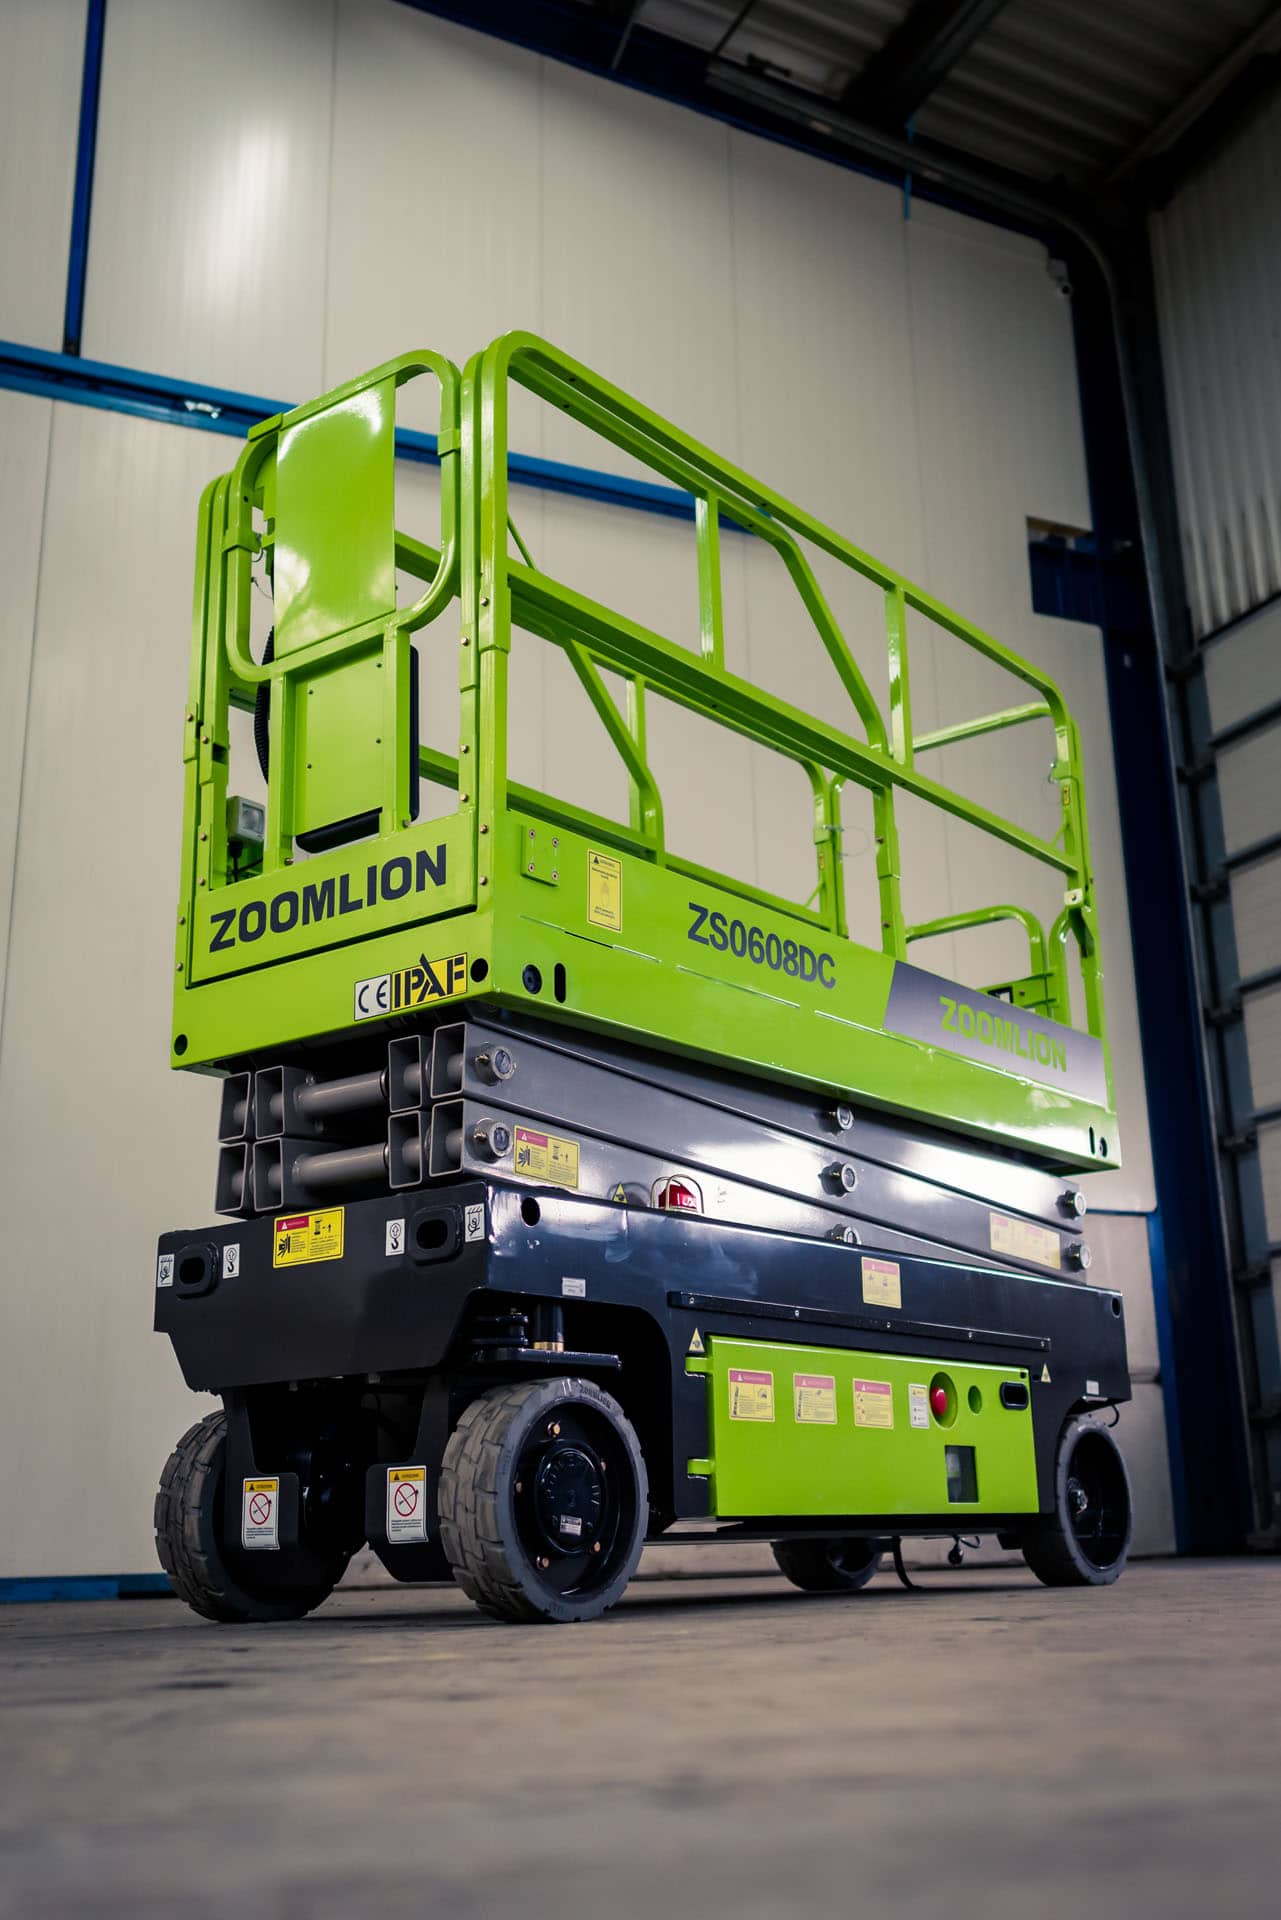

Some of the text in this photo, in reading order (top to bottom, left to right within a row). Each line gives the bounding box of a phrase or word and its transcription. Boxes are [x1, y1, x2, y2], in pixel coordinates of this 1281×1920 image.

[209, 845, 446, 952] ZOOMLION
[394, 953, 464, 1008] IPAF
[688, 902, 836, 988] ZS0608DC
[358, 979, 387, 1013] CE
[939, 998, 1067, 1072] ZOOMLION
